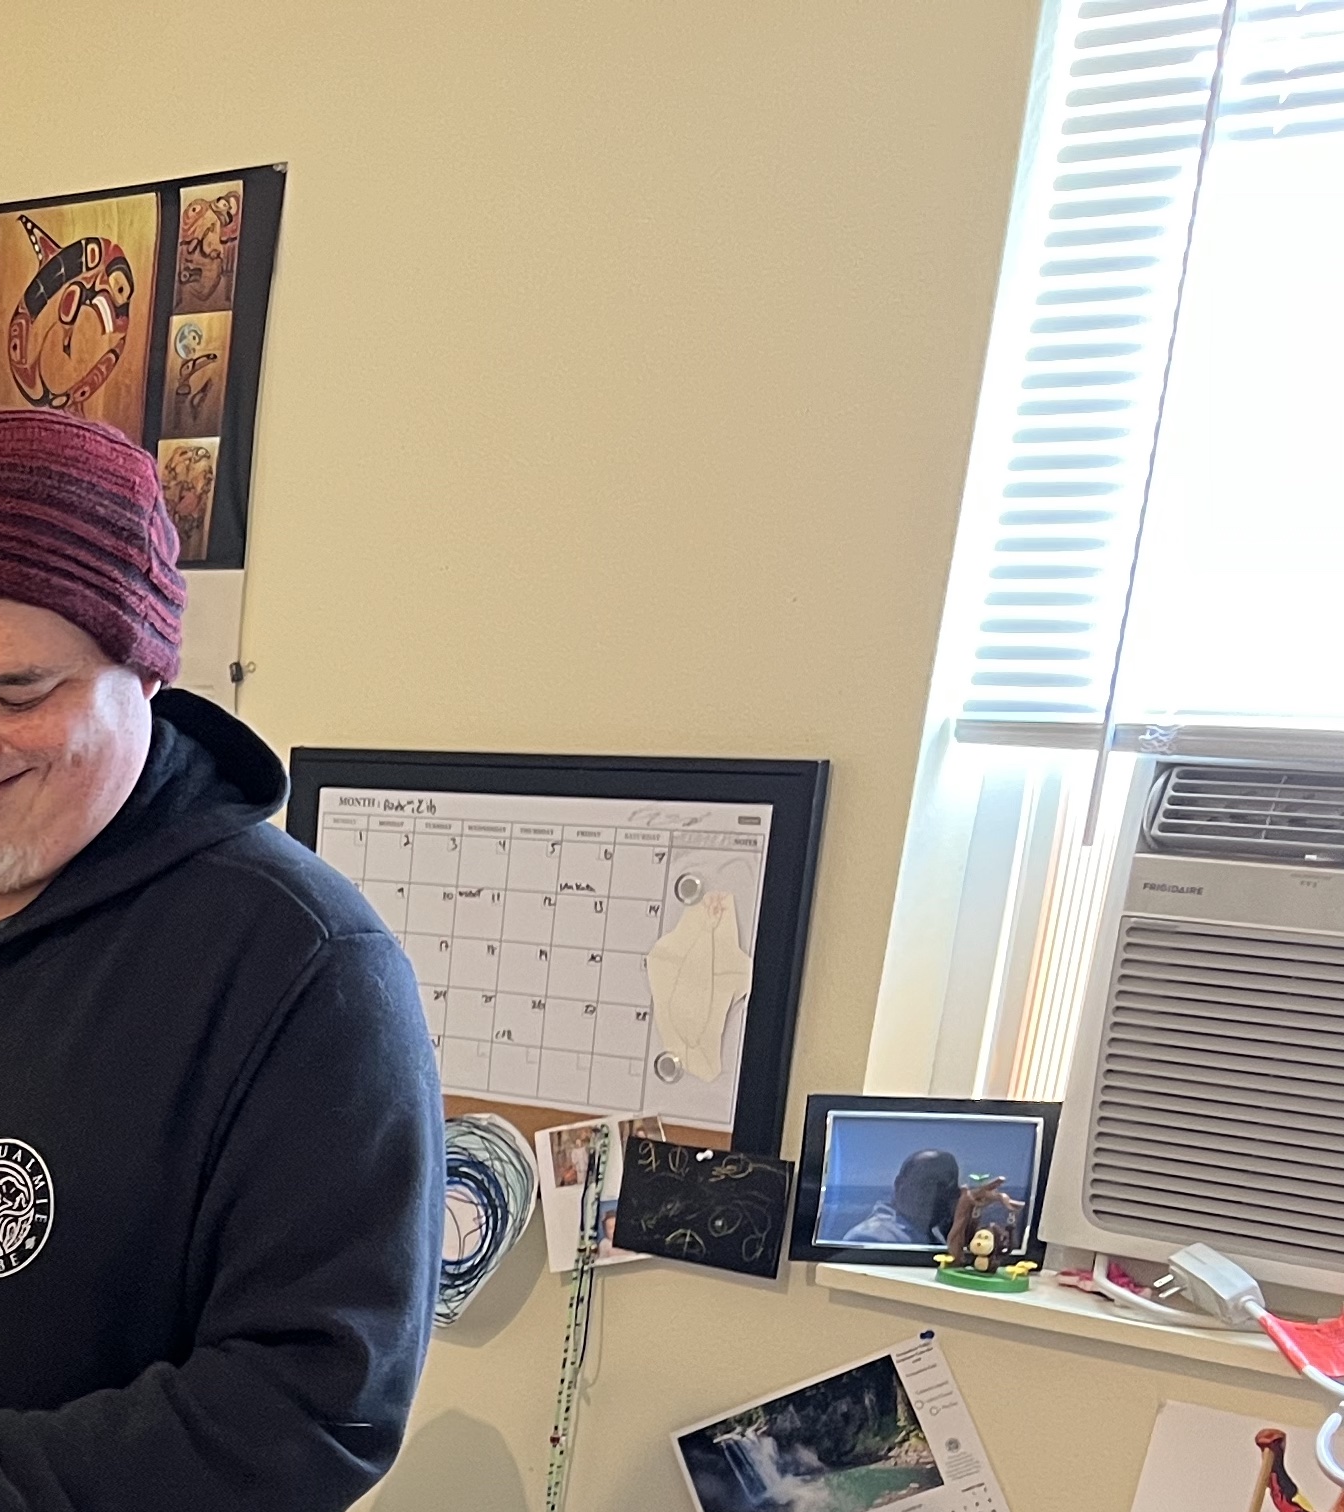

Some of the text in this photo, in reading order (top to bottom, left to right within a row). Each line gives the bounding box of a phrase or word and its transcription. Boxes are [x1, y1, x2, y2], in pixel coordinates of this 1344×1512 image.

[448, 837, 459, 852] 3
[498, 838, 506, 852] 4
[603, 847, 612, 861] 6
[655, 851, 666, 863] 7
[441, 890, 454, 901] 10
[1142, 882, 1204, 896] FRIGIDAIRE
